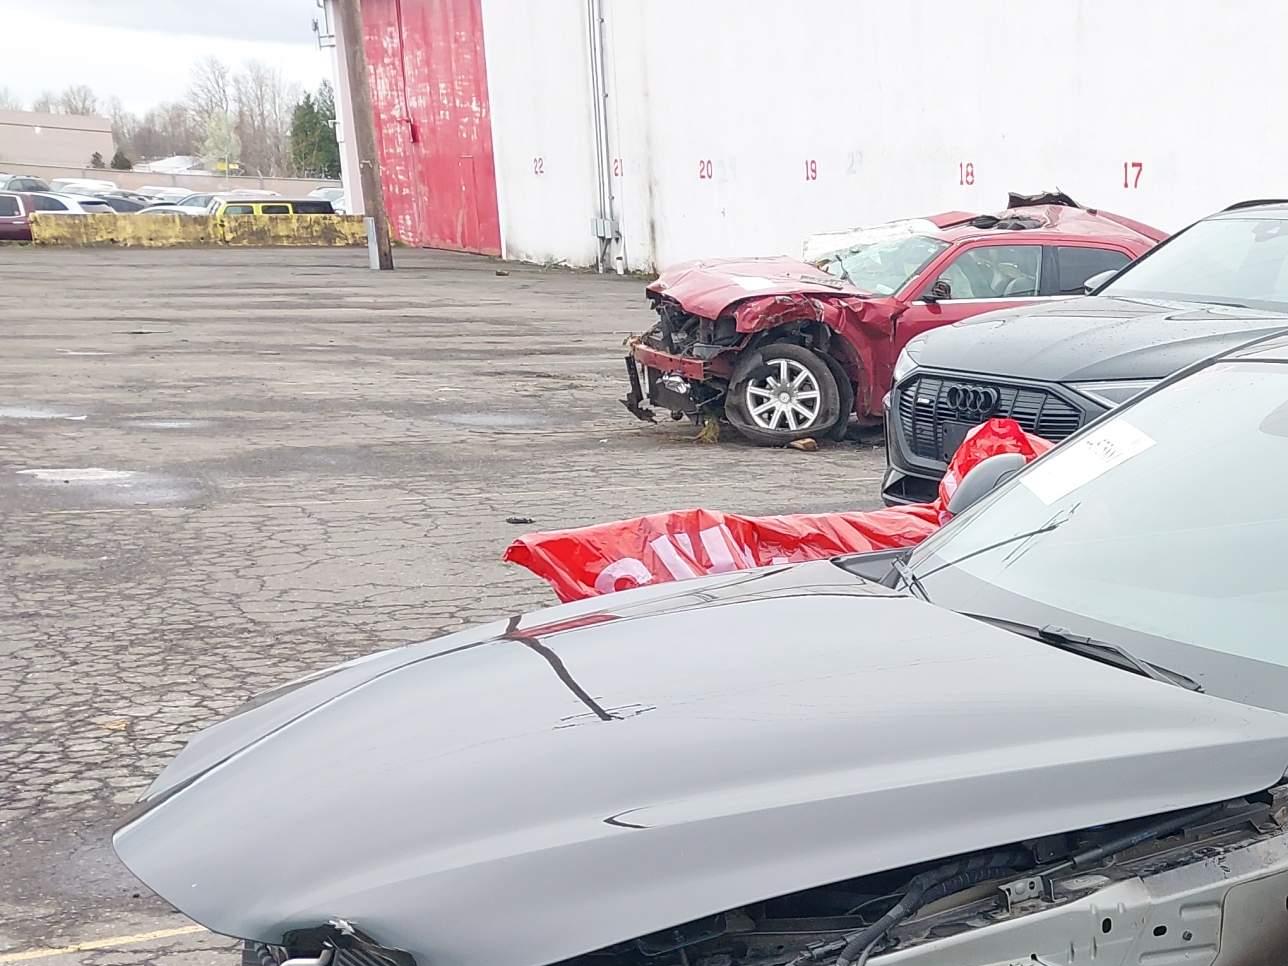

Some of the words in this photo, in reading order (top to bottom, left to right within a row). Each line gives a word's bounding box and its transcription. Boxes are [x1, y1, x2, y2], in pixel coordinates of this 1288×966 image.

[533, 157, 545, 175] 22
[613, 158, 624, 177] 21
[699, 159, 713, 180] 20
[805, 159, 817, 181] 19
[959, 162, 975, 186] 18
[1123, 162, 1143, 189] 17
